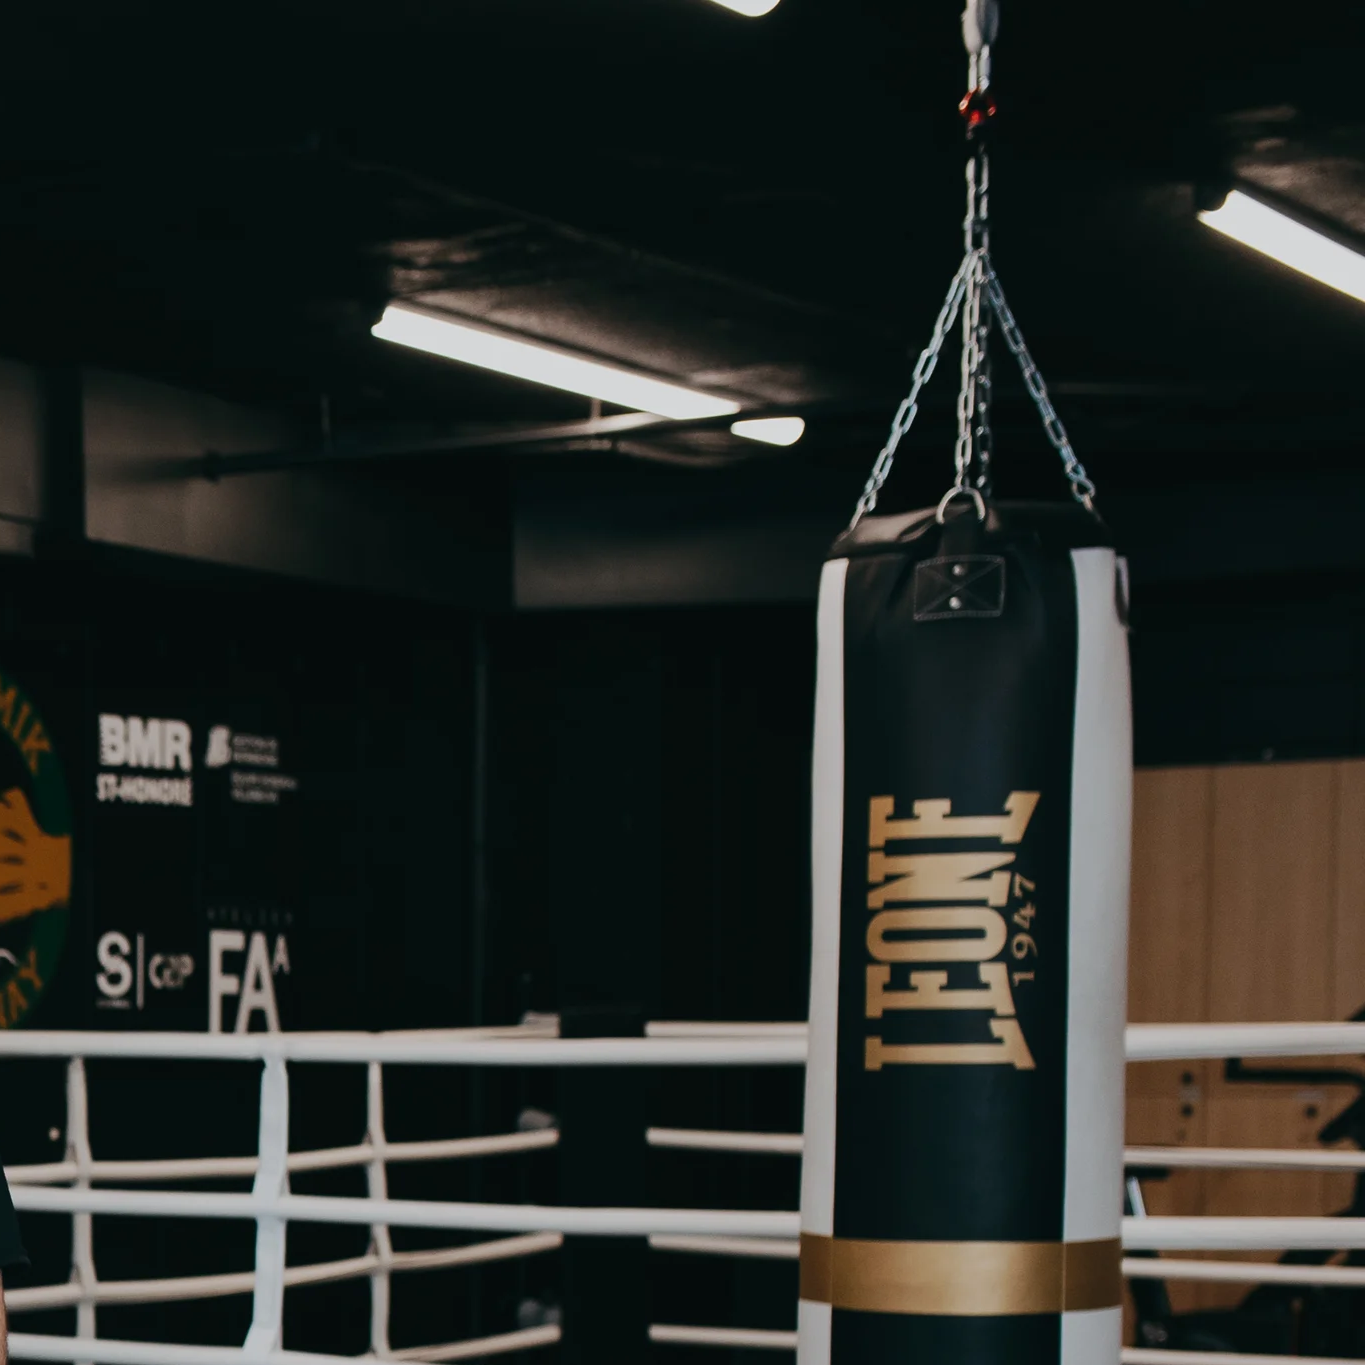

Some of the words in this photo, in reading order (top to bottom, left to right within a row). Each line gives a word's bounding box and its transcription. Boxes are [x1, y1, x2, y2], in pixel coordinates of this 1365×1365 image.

[98, 713, 192, 772] BMR
[864, 791, 1040, 1070] LEONE
[1011, 873, 1037, 986] 1947
